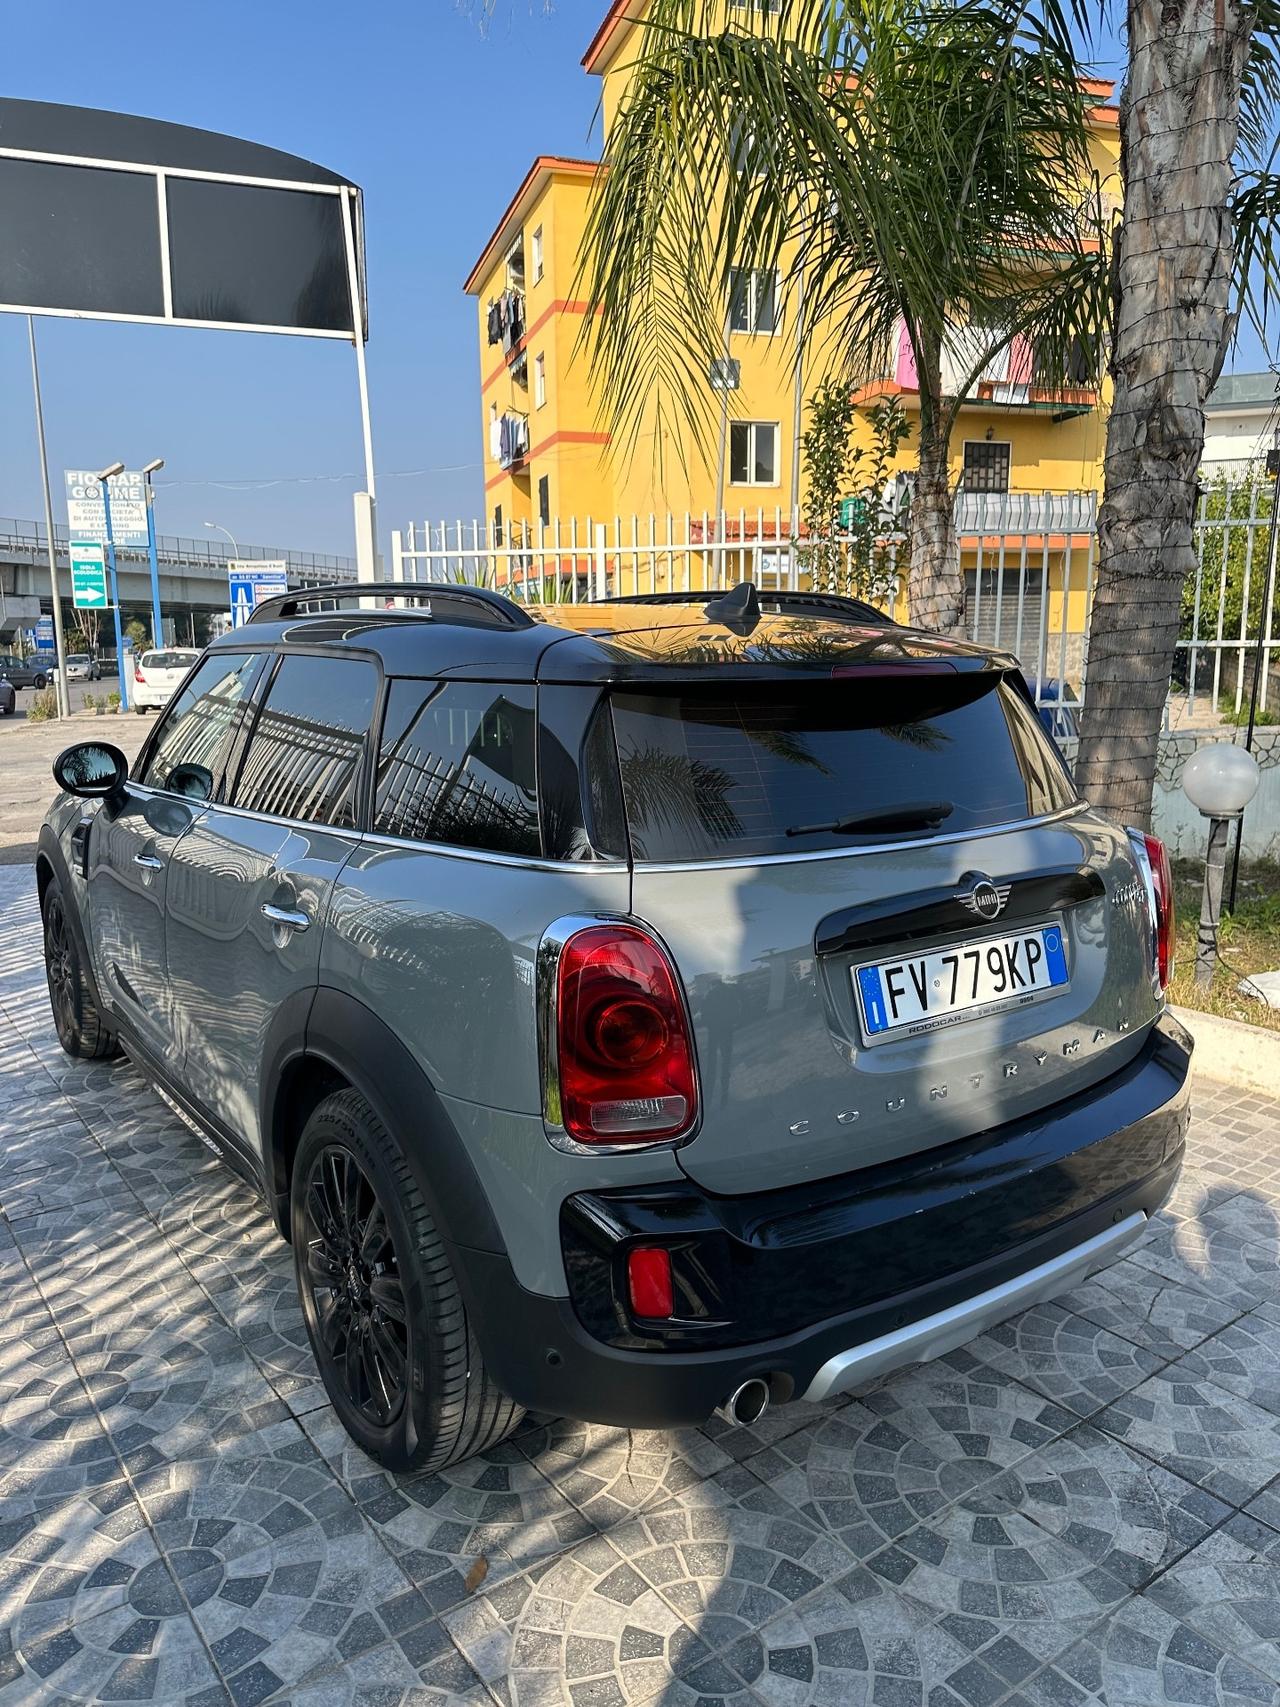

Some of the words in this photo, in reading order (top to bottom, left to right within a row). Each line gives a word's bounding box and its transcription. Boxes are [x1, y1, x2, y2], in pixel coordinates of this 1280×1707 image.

[976, 893, 998, 907] MINI
[885, 962, 928, 1019] FV
[941, 938, 1042, 1006] 779KP
[908, 1015, 962, 1035] RODOCAR
[788, 1016, 1131, 1137] COUNTRYMAN
